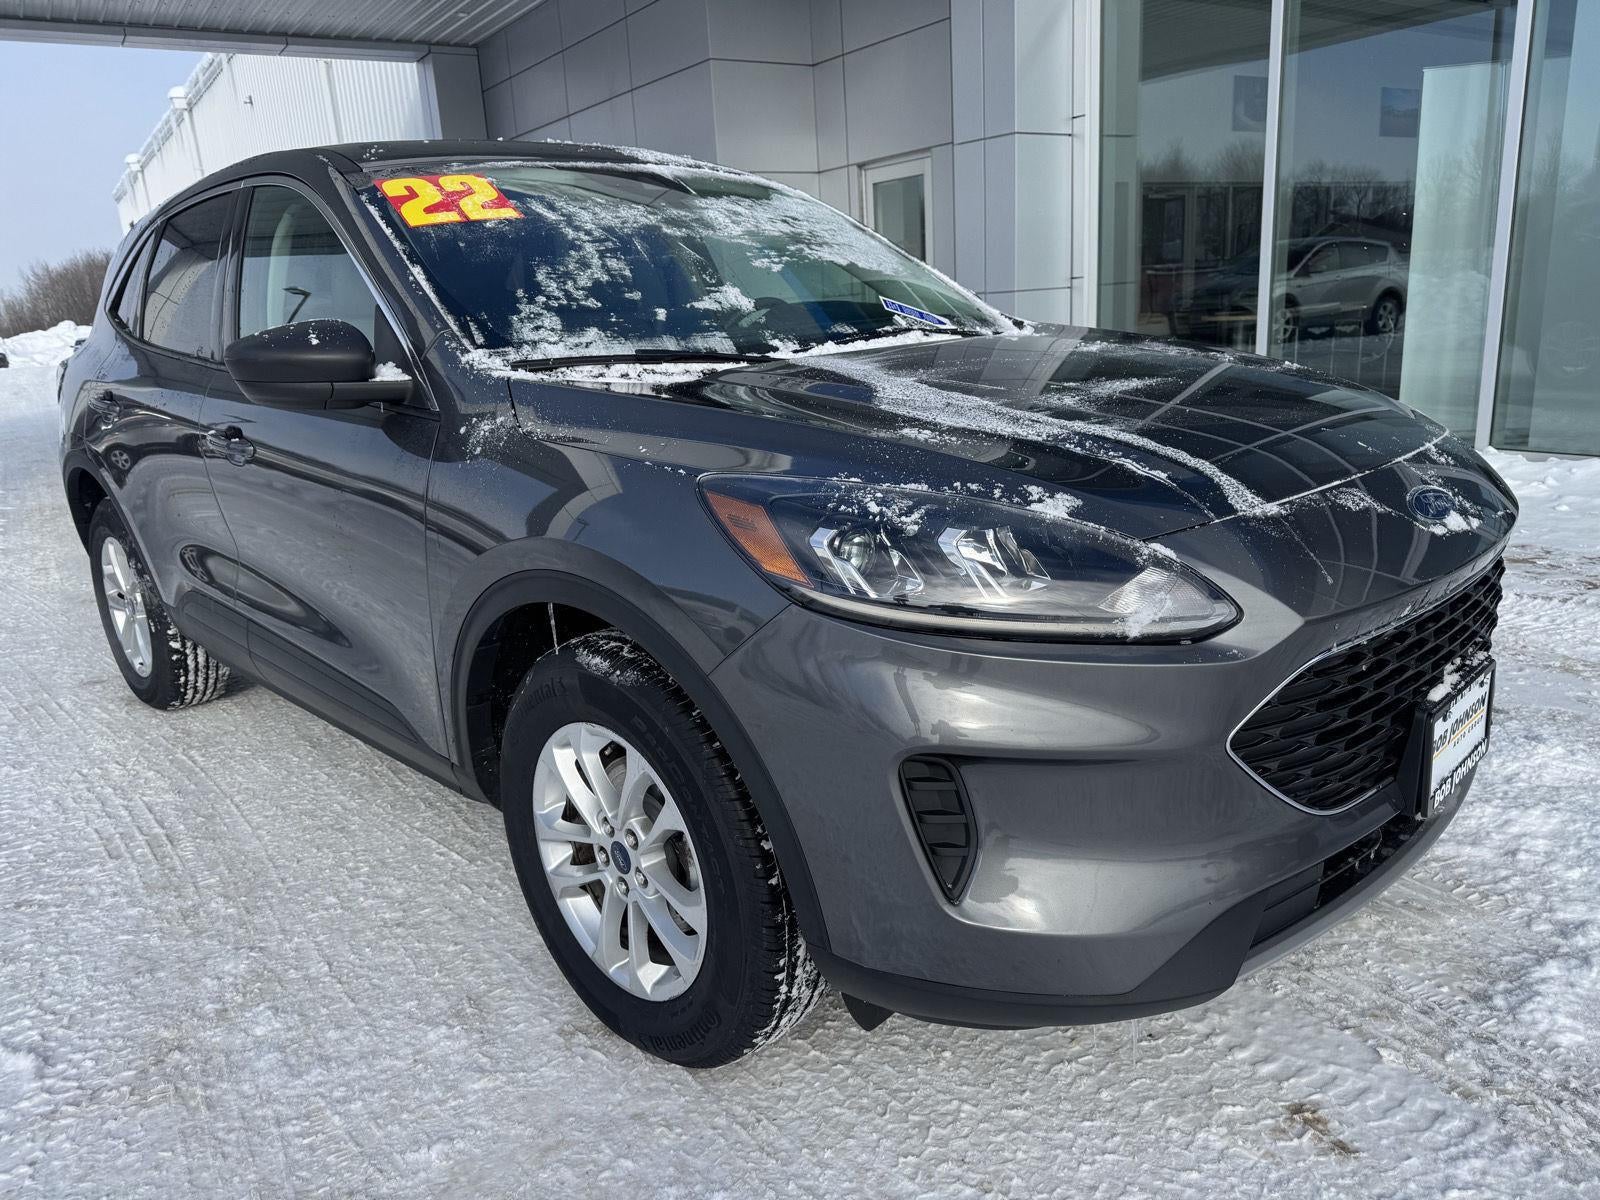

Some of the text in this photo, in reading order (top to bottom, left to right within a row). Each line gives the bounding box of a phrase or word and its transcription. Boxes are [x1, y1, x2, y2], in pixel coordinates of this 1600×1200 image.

[381, 174, 520, 227] 22
[1447, 691, 1487, 746] JOHNSON
[1453, 714, 1483, 748] AUTO GROUP
[1433, 738, 1487, 809] BOB JOHNSON
